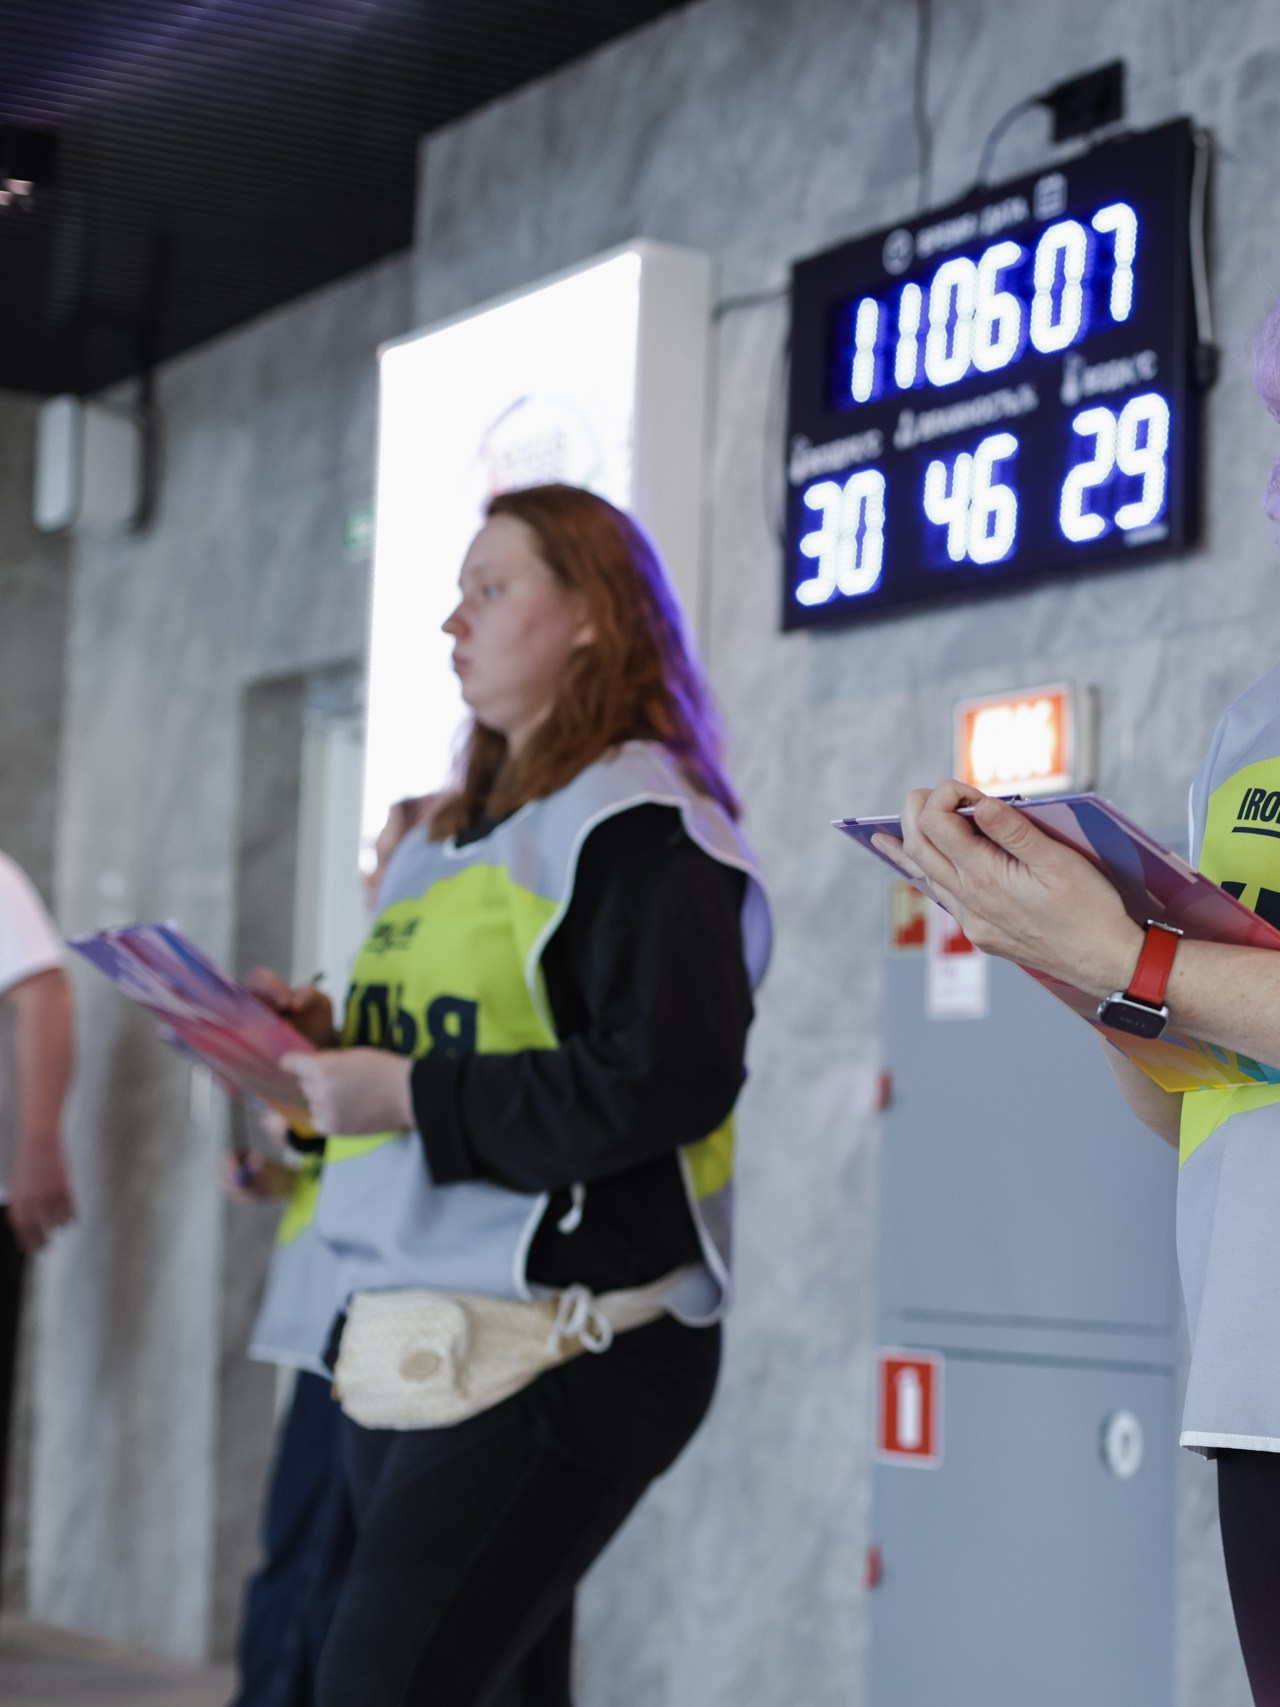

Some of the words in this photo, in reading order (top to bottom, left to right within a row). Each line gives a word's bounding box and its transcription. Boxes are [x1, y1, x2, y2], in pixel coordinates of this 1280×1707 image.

[796, 470, 886, 606] 30
[924, 433, 1018, 565] 46
[1060, 392, 1169, 541] 29
